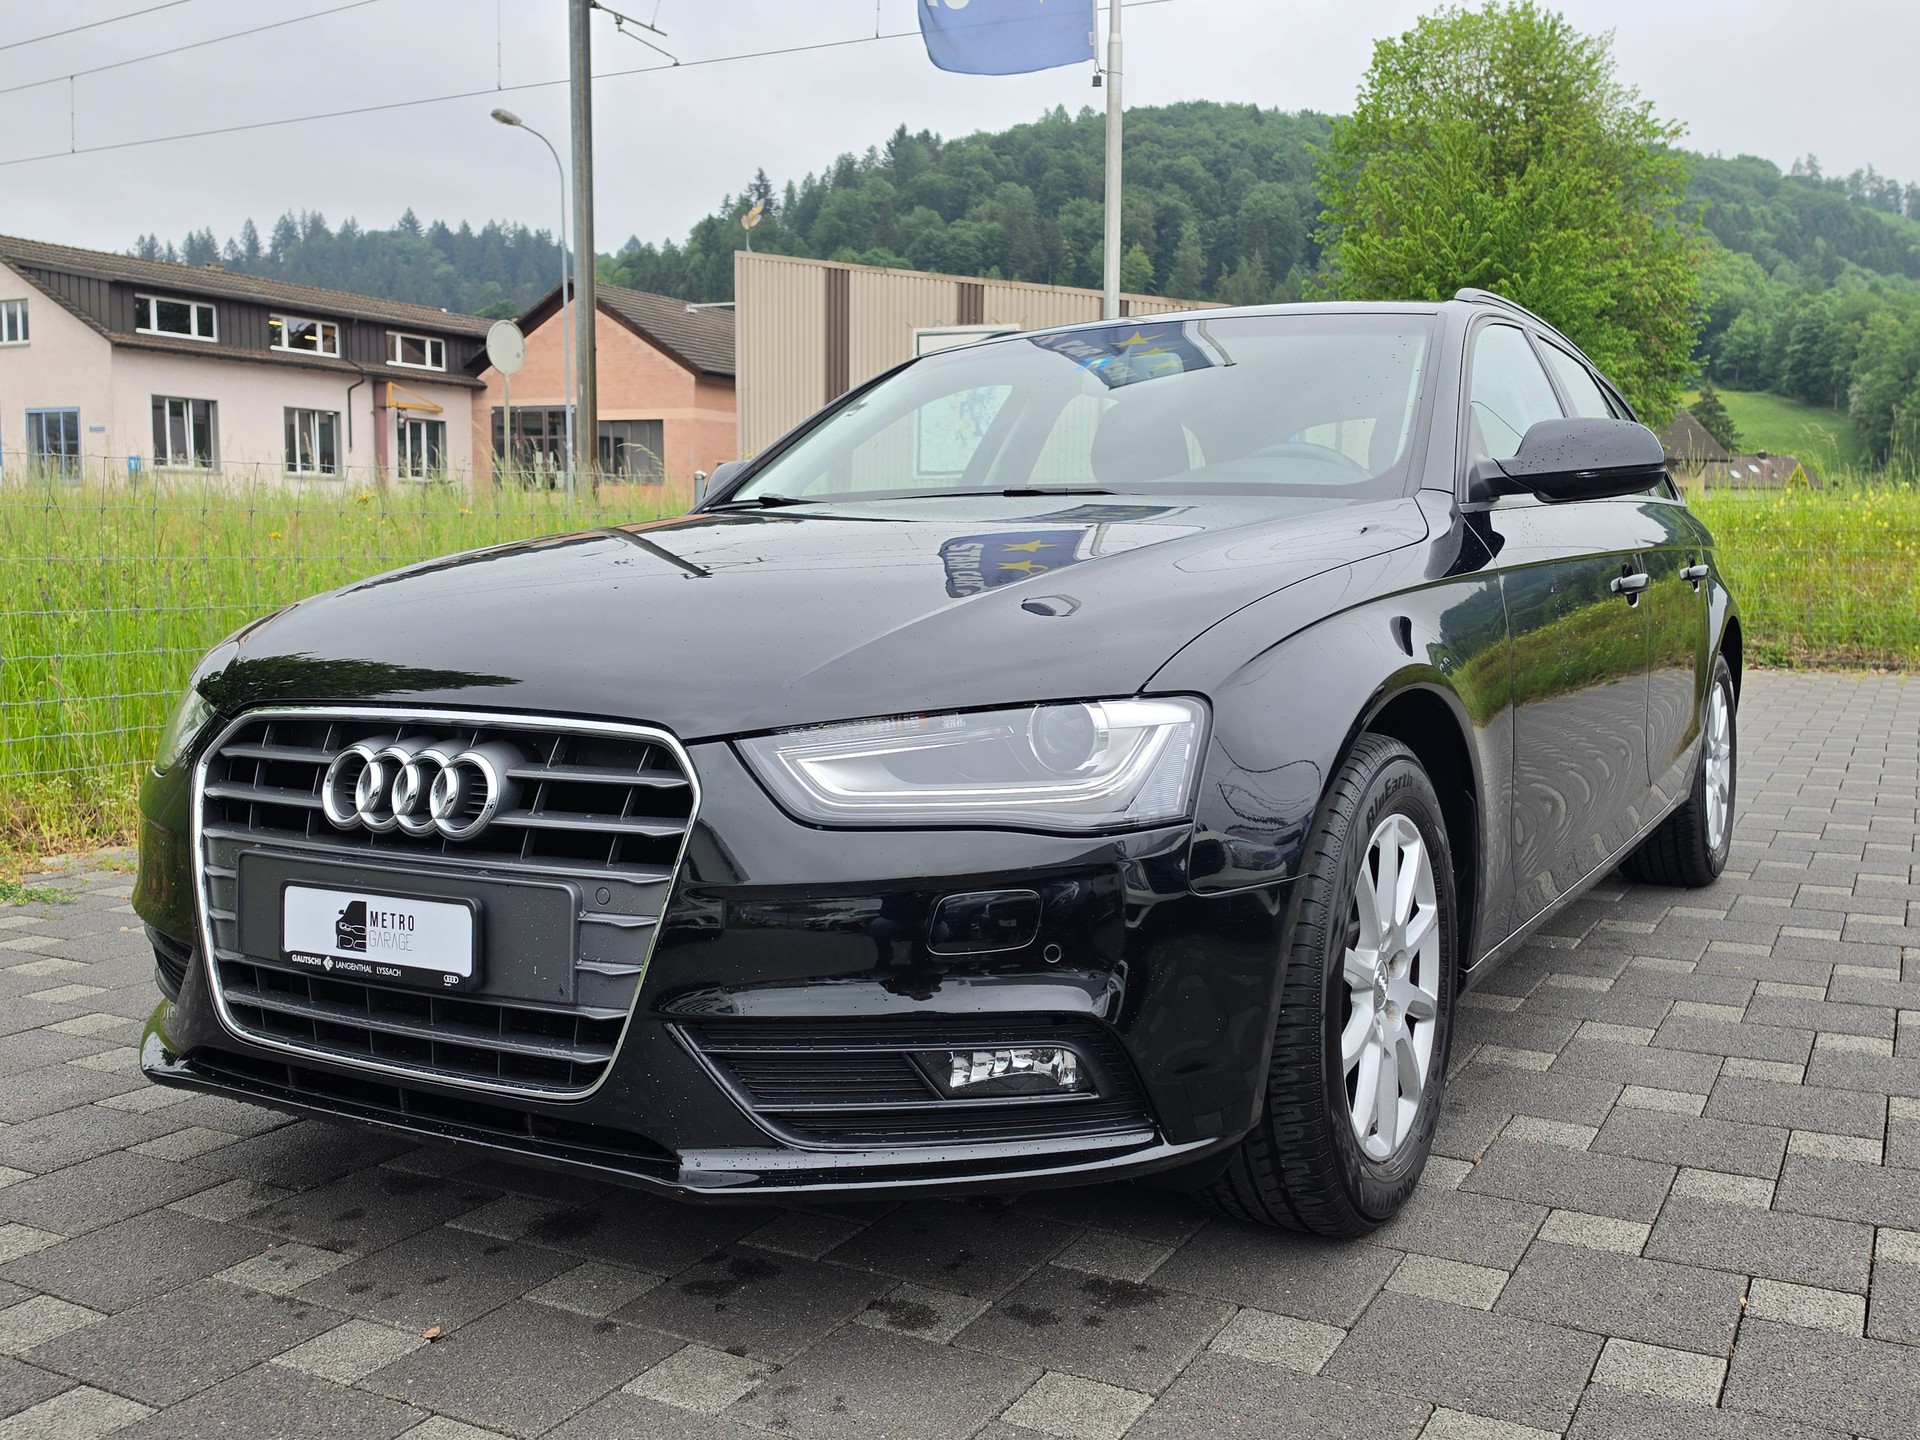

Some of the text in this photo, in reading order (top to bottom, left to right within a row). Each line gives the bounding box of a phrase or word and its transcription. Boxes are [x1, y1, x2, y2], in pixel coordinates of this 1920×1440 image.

[946, 543, 985, 569] STAR
[369, 910, 415, 932] METRO
[369, 930, 413, 951] GARAGE
[291, 954, 402, 977] GAUTSCHI LANGENTHAL LYSSACH
